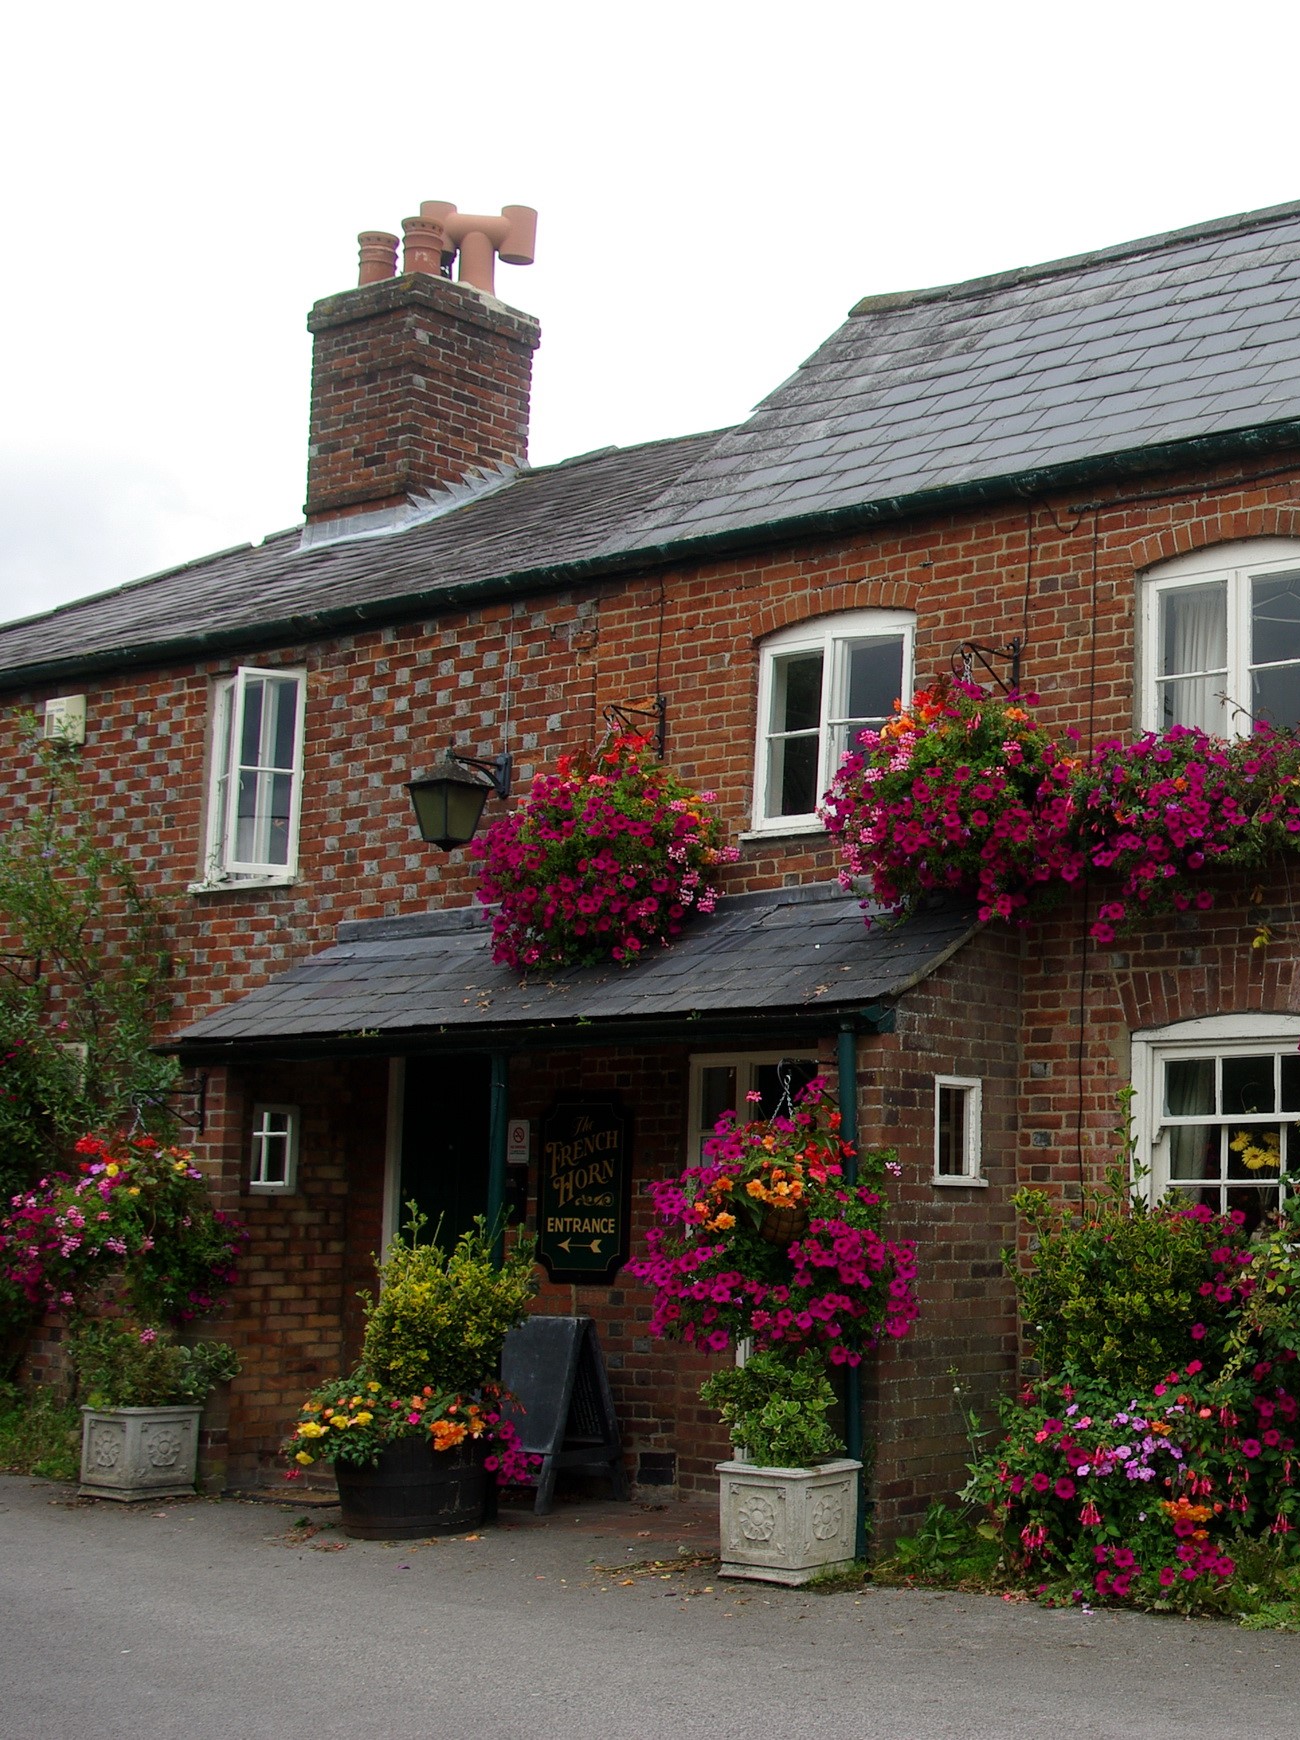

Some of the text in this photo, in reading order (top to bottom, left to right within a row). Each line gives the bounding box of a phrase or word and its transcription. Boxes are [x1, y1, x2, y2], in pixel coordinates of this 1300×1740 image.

[572, 1115, 594, 1136] The
[546, 1130, 619, 1178] FRENCH
[553, 1158, 616, 1208] HORN
[547, 1217, 616, 1234] ENTRANCE
